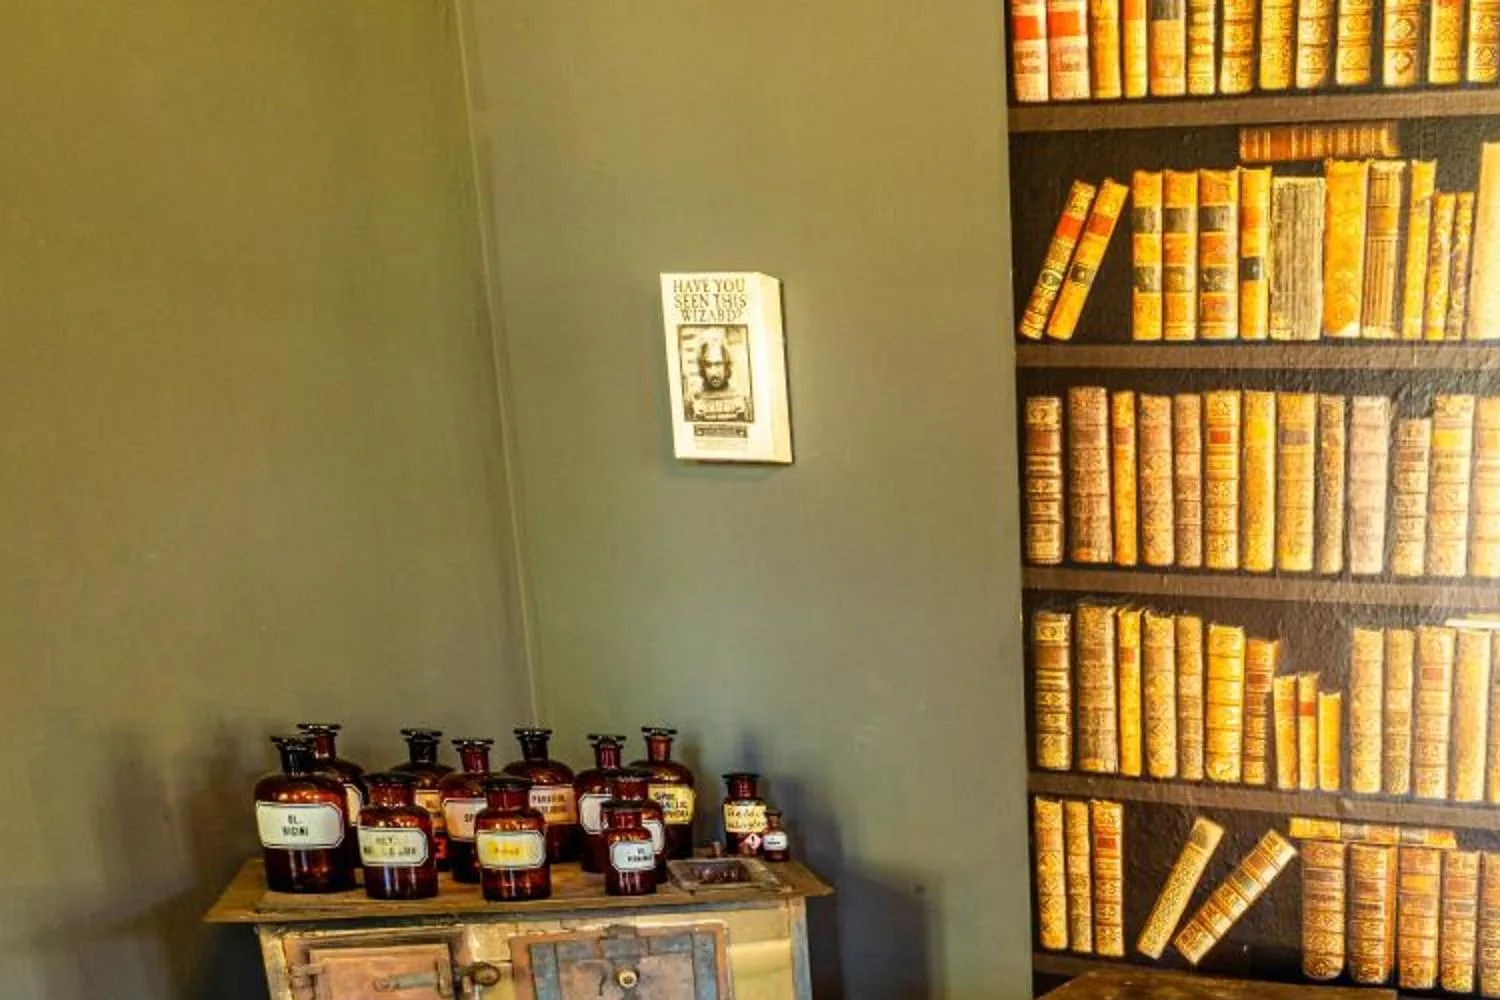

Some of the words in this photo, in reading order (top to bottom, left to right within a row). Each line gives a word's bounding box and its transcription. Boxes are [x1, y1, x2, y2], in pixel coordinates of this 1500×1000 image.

[673, 279, 710, 293] HAVE
[713, 277, 745, 293] YOU
[674, 293, 709, 309] SEEN
[712, 293, 747, 309] THIS
[681, 308, 744, 322] WIZARD?
